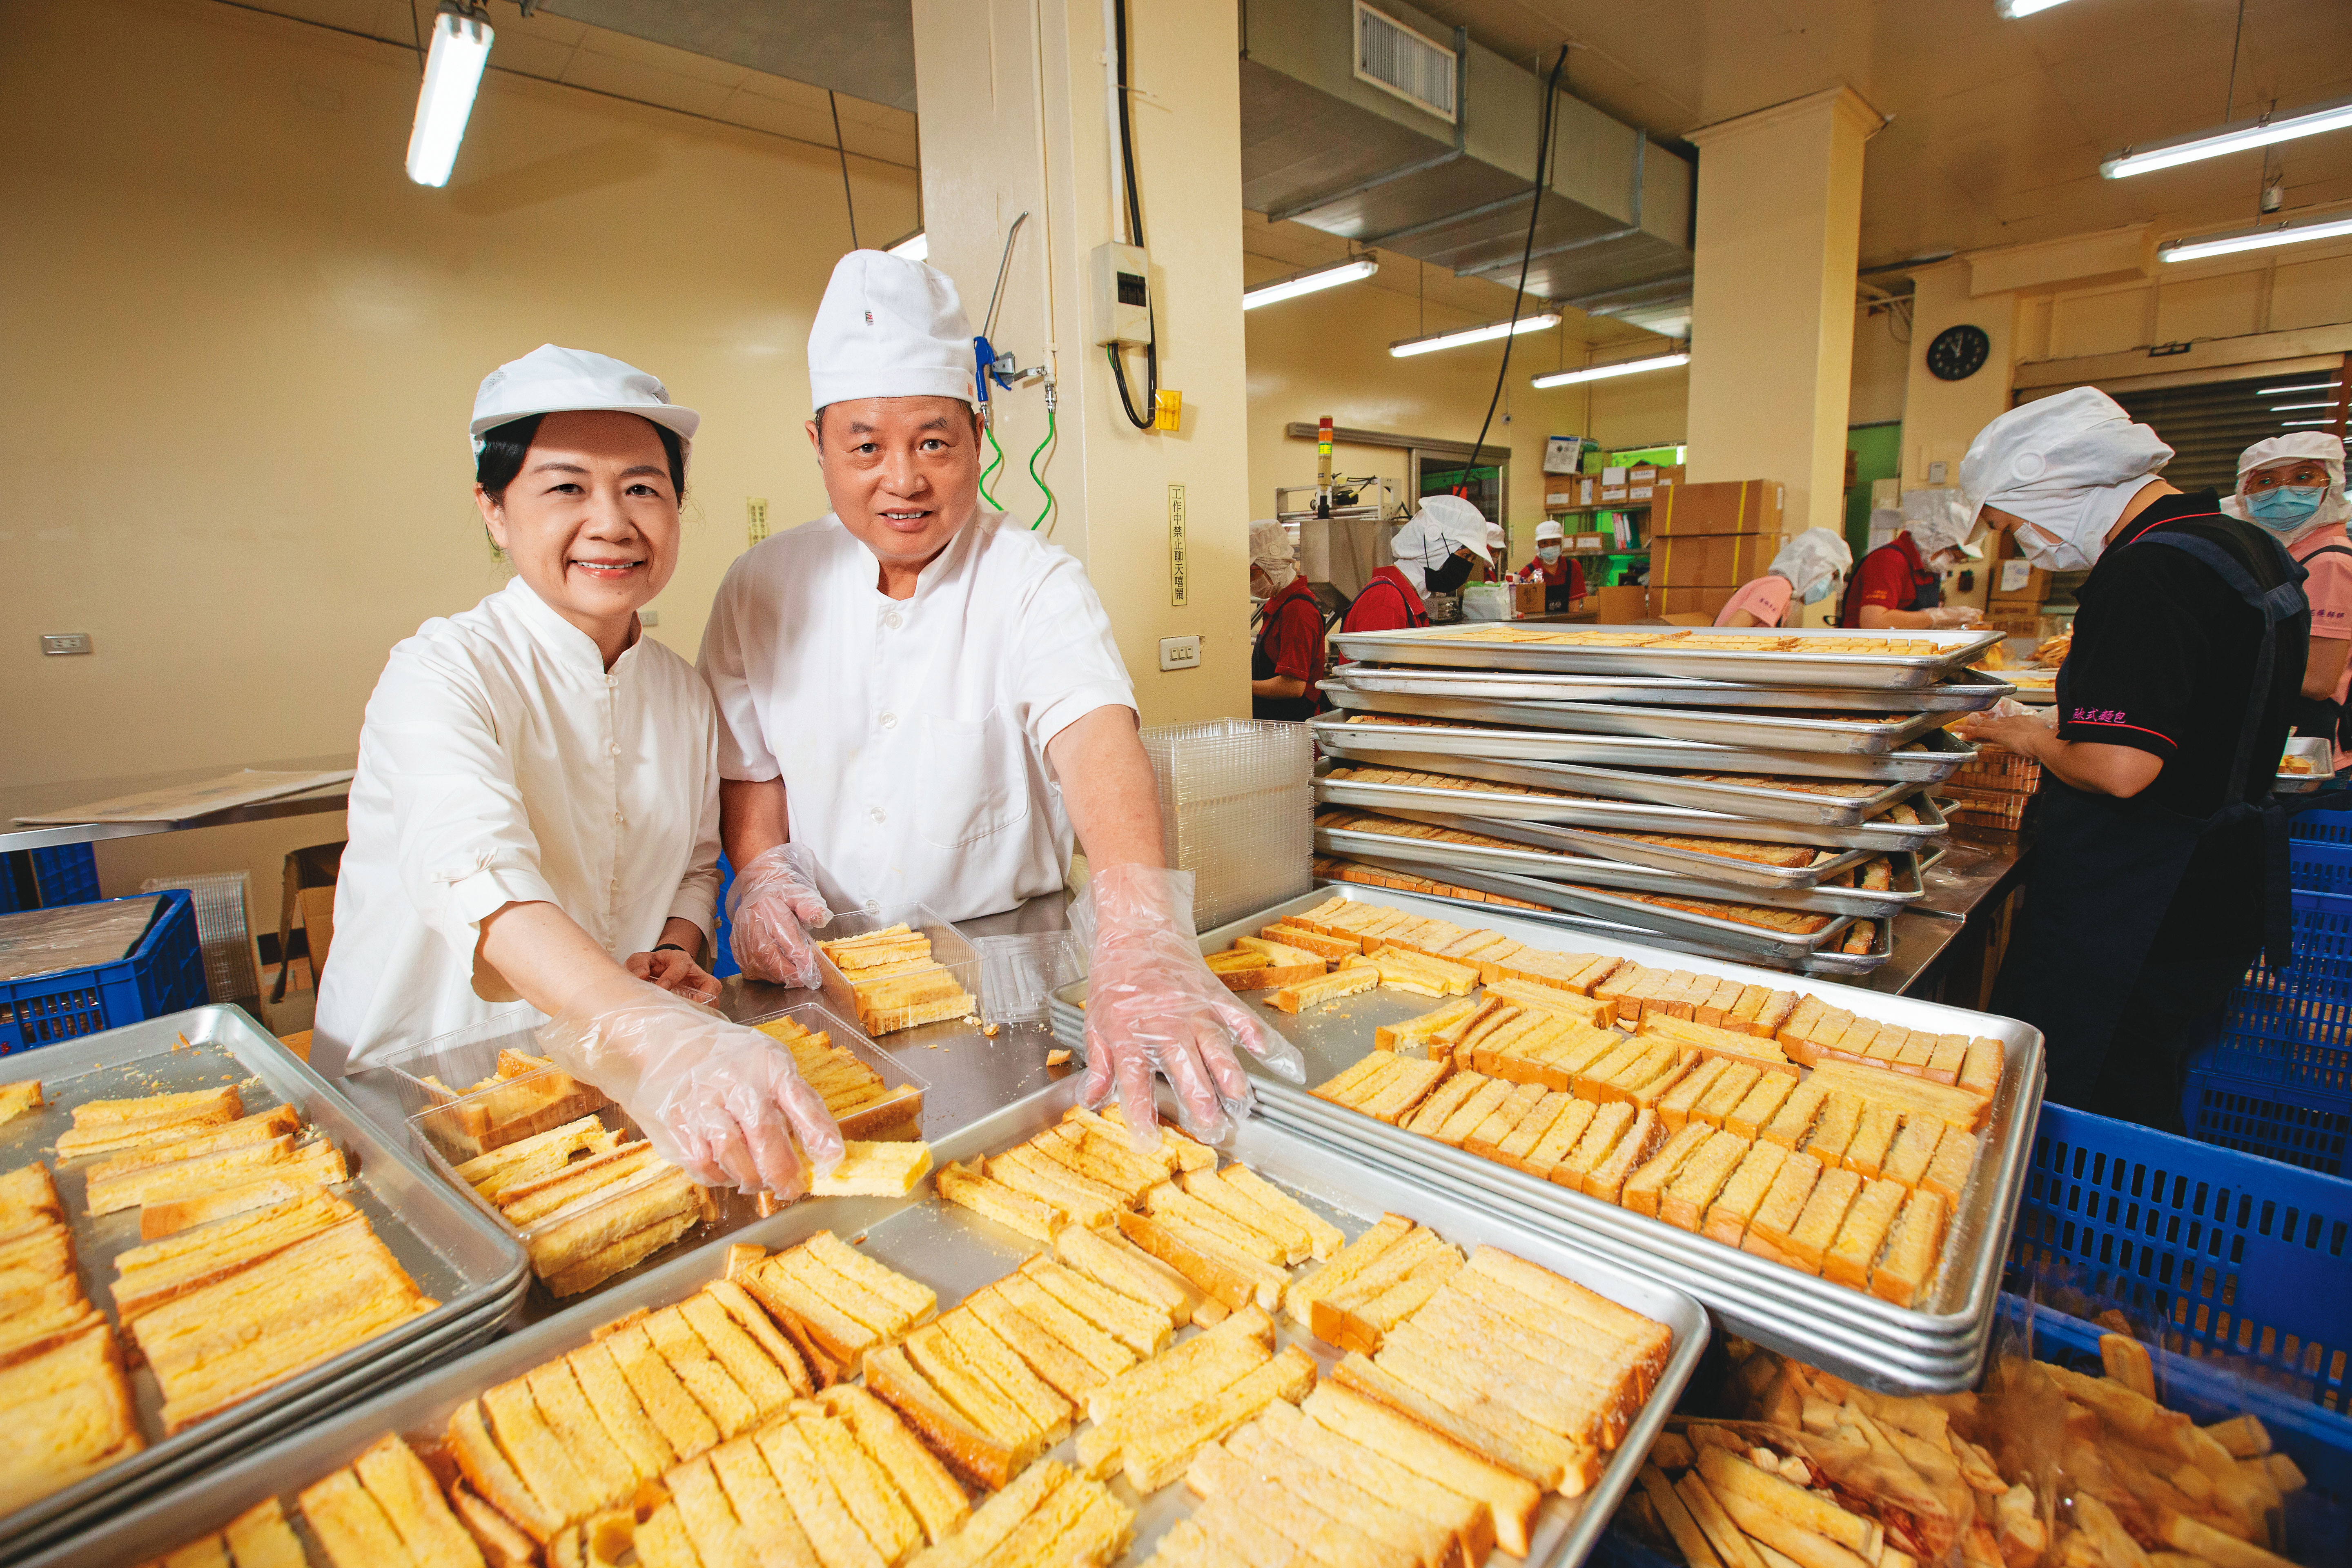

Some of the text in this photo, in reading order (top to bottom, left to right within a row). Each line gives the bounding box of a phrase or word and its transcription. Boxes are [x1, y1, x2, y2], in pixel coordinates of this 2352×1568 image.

[1172, 488, 1184, 600] 工作中禁止聊天嘻鬧
